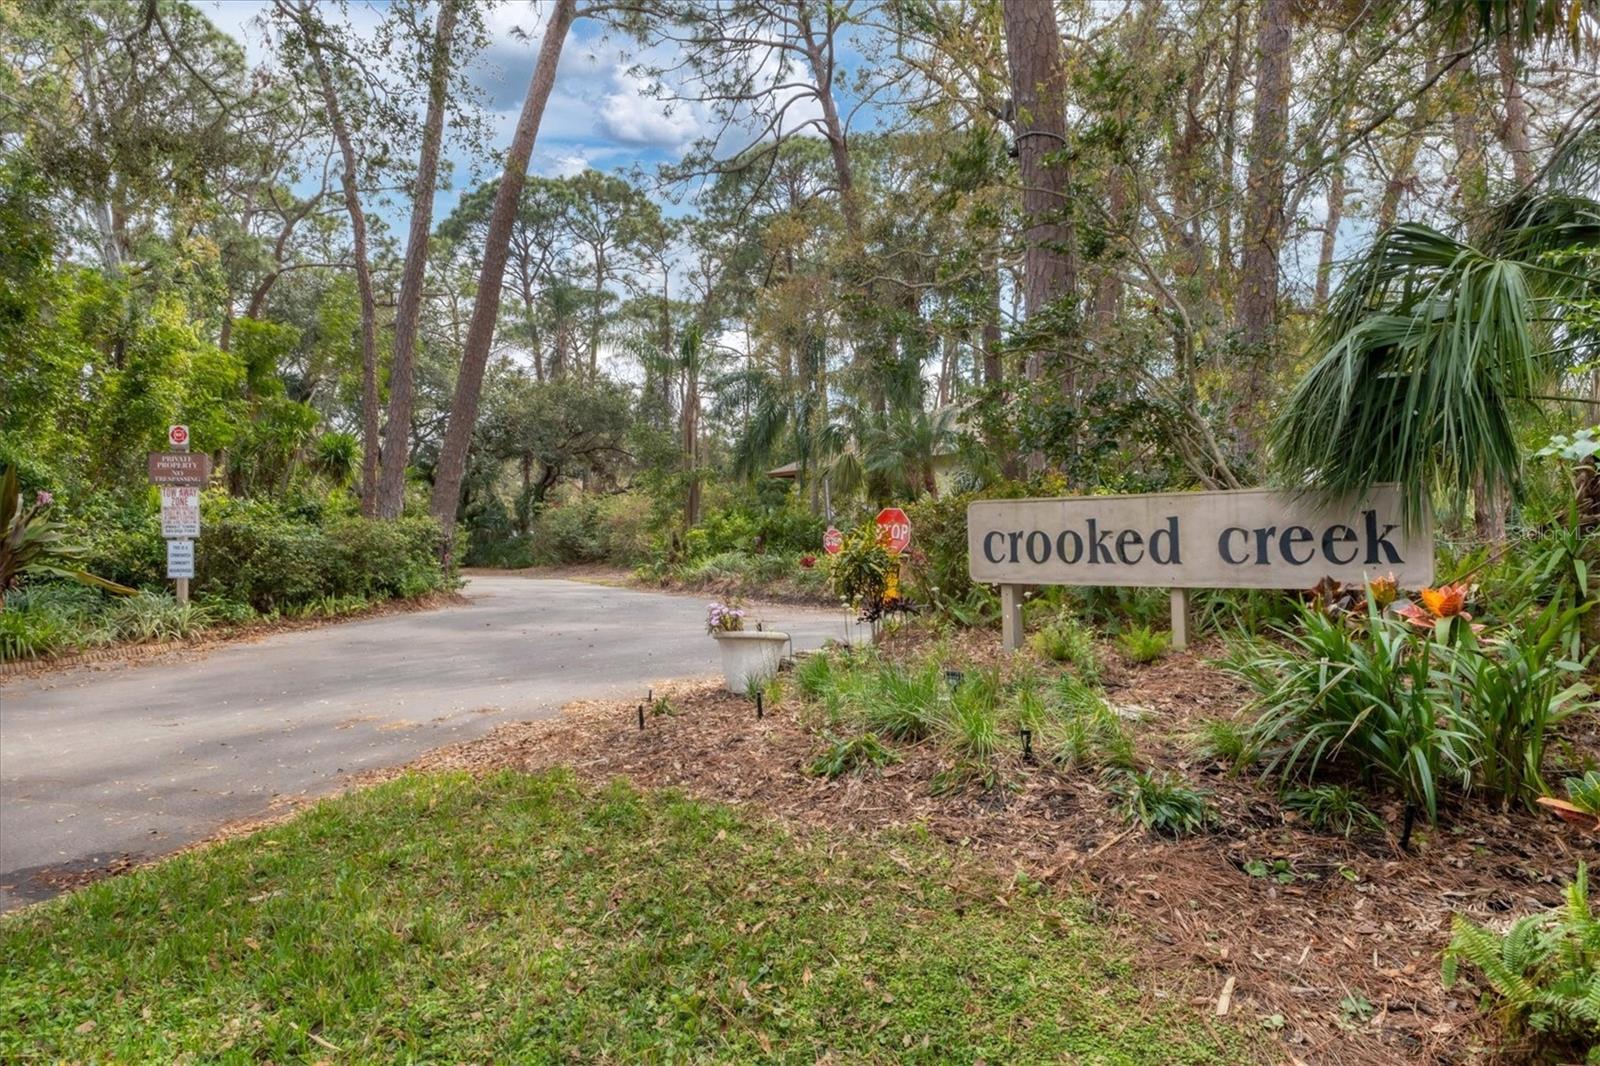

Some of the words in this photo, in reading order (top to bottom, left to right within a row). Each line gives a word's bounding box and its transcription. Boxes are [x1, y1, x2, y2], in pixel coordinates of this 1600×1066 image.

[163, 487, 177, 497] TOW
[178, 487, 197, 497] AWAY
[171, 496, 188, 506] ZONE
[982, 515, 1183, 565] crooked
[1217, 509, 1405, 566] creek
